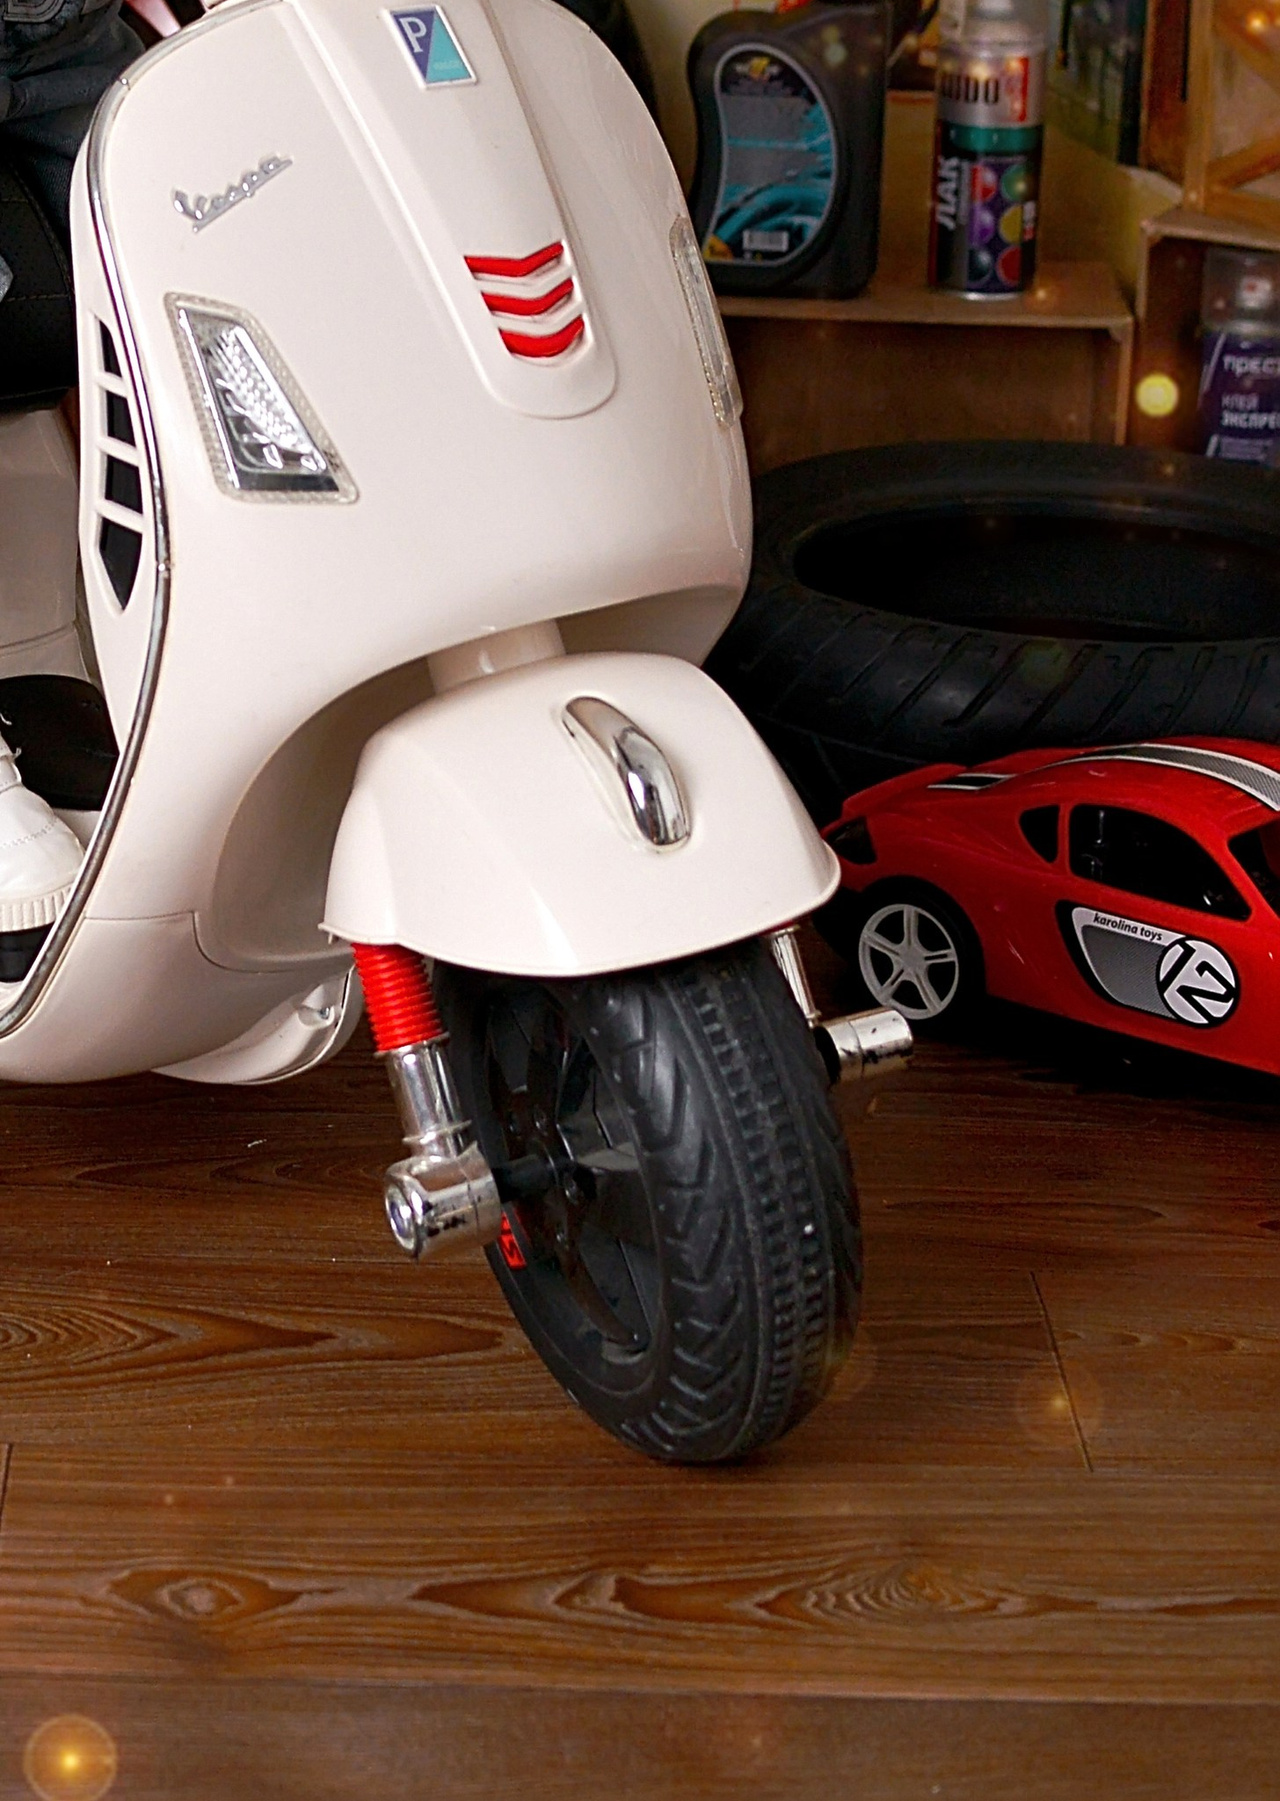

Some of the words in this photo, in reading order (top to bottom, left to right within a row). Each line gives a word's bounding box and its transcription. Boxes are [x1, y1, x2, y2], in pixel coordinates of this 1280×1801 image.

[399, 16, 427, 53] P
[173, 154, 293, 234] Vespa
[1093, 912, 1138, 935] karolina
[1140, 926, 1164, 943] toys
